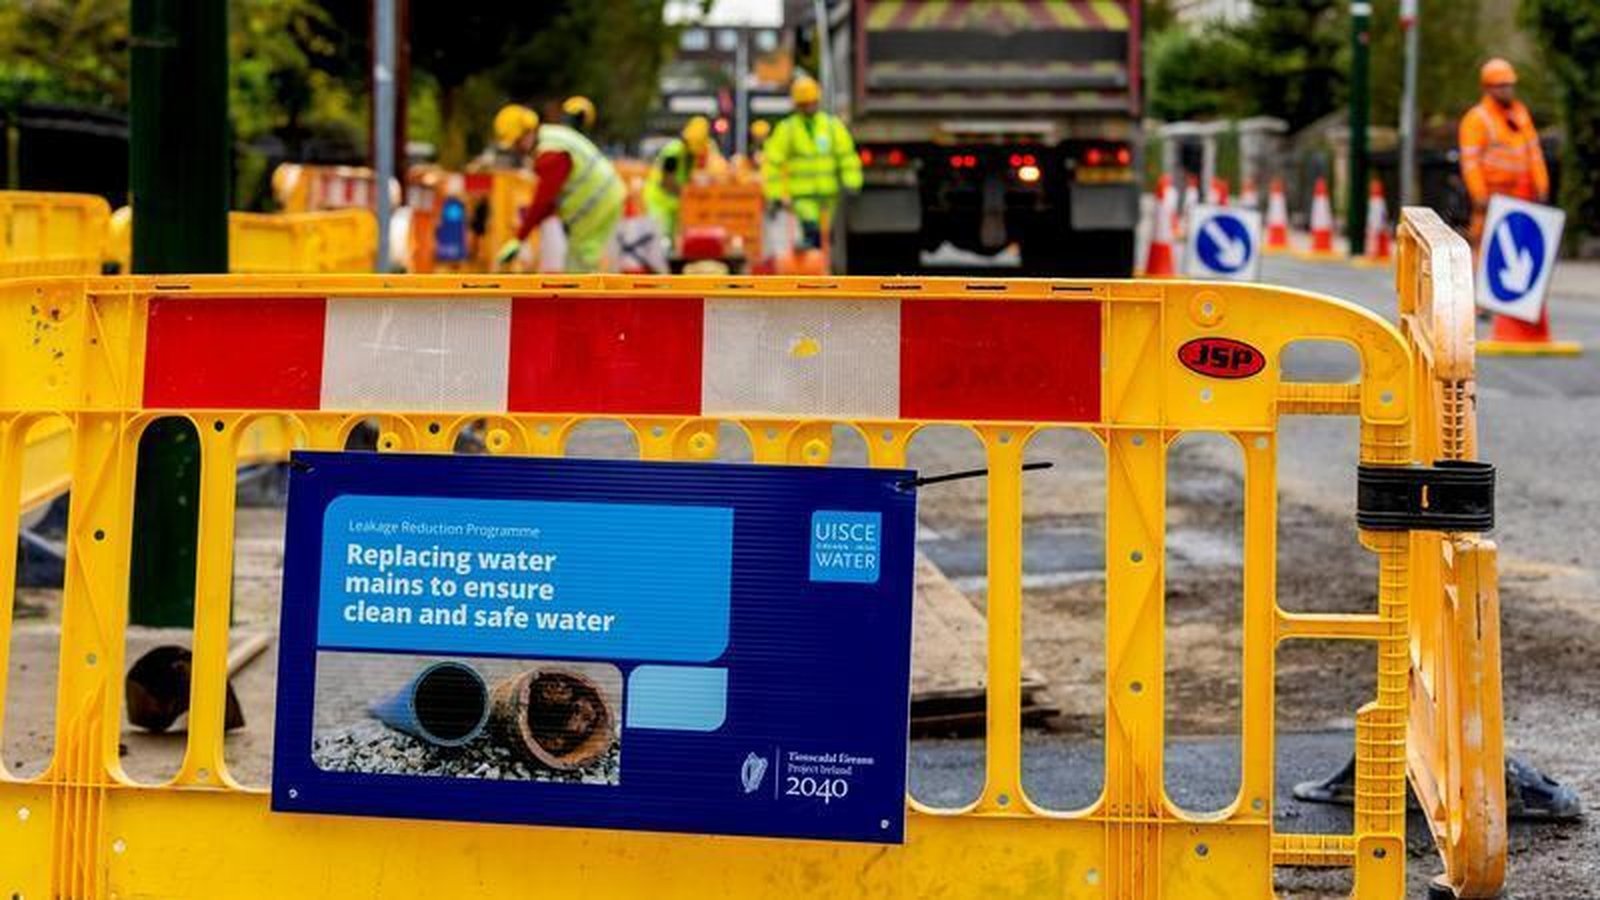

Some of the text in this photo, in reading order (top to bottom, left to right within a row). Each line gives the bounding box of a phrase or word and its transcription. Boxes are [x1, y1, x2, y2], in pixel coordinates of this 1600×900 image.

[1191, 344, 1253, 370] JSP
[348, 519, 541, 539] Leakage Reduction Programme
[815, 523, 876, 542] UISCE
[347, 543, 557, 575] Replacing water
[815, 552, 876, 569] WATER
[344, 572, 554, 601] mains to ensure
[343, 600, 616, 632] clean and safe water
[786, 777, 848, 804] 2040
